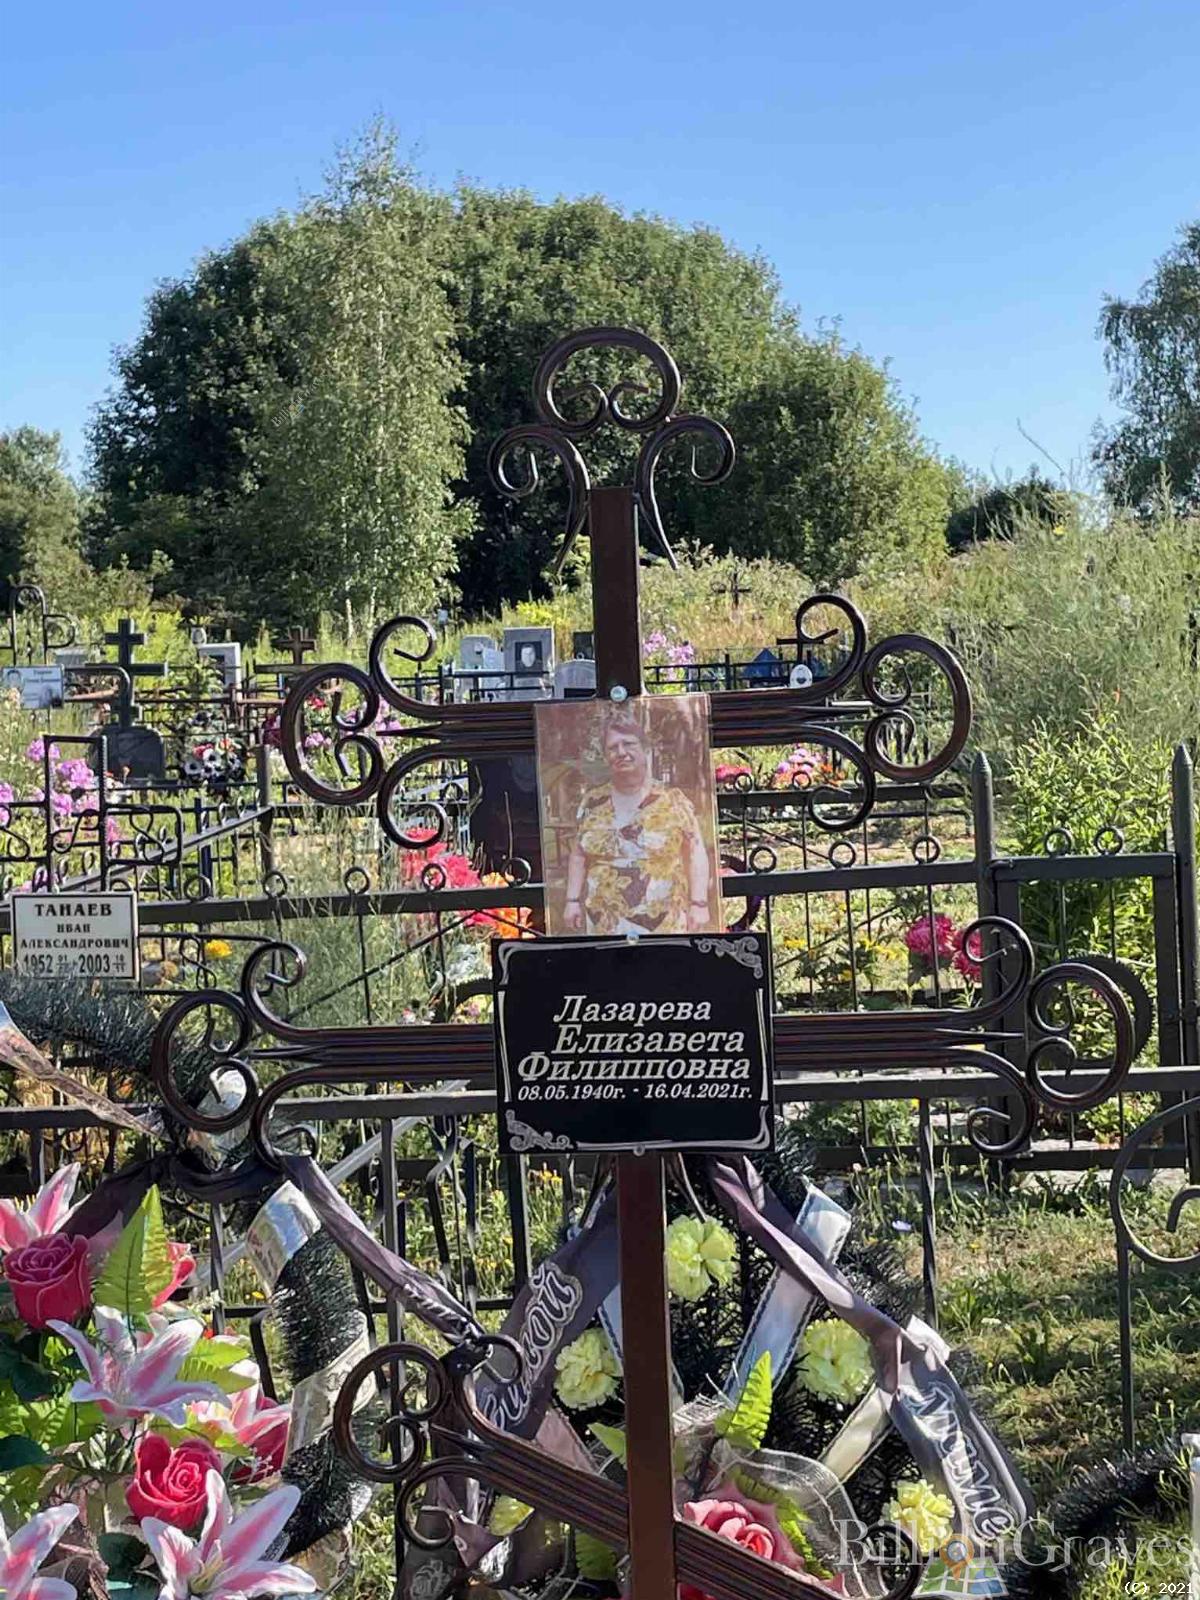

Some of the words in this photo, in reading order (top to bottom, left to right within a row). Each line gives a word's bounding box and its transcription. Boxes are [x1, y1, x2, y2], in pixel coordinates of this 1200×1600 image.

[35, 903, 112, 917] ТАНАЕВ
[56, 923, 91, 933] ИВАН
[21, 938, 129, 949] АЛЕКСАНДРОВИЧ
[78, 953, 110, 973] 2003
[553, 995, 712, 1027] Лазарева
[551, 1023, 745, 1054] Елизавета
[517, 1051, 751, 1081] Филипповна
[517, 1085, 627, 1101] 08.05.1940г.
[643, 1083, 753, 1099] 16.04.2021г.
